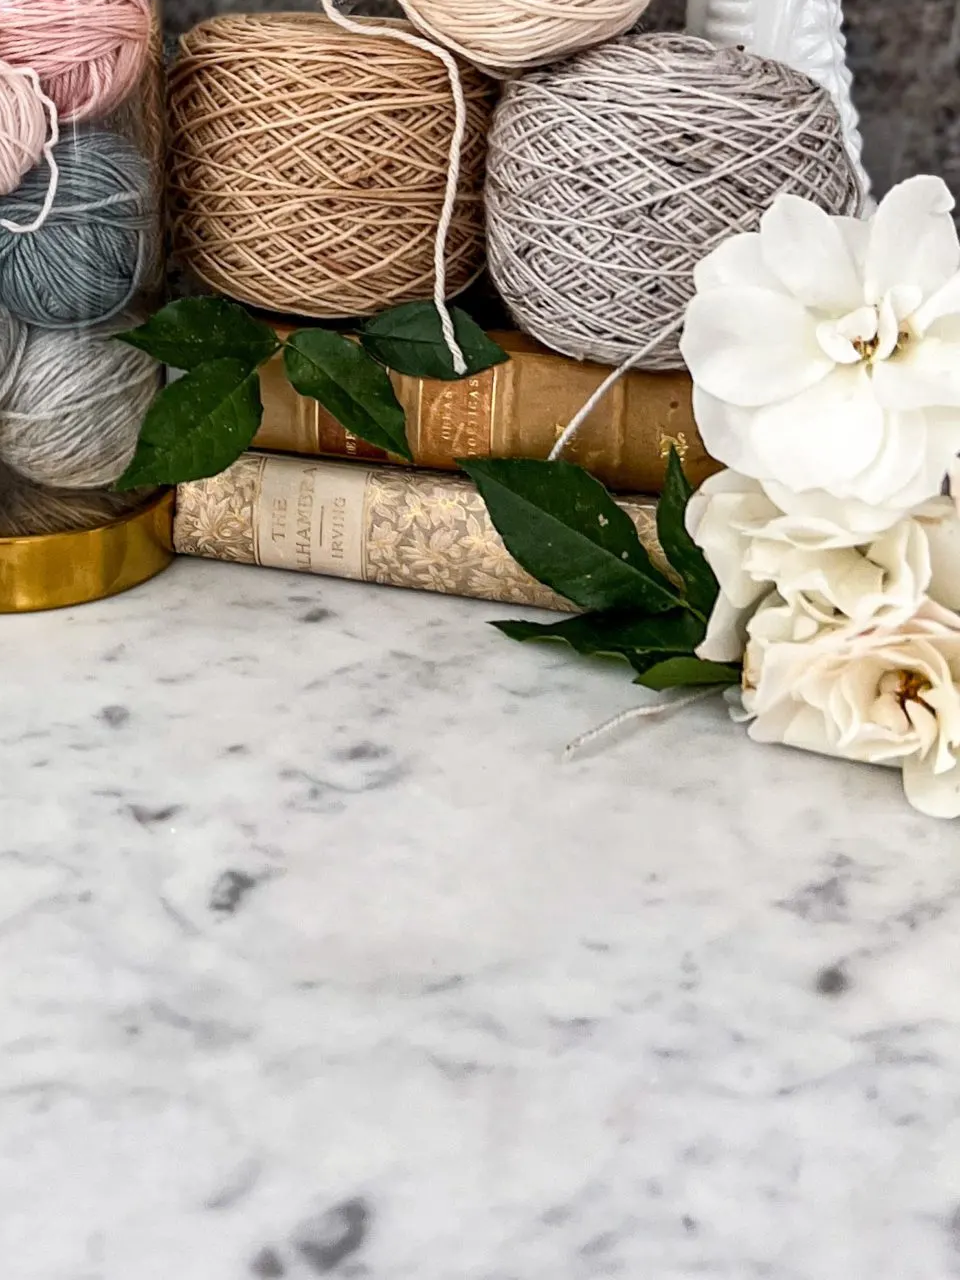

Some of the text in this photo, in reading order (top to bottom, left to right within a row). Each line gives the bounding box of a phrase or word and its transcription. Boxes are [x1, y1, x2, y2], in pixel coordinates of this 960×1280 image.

[271, 497, 287, 543] THE
[295, 467, 317, 573] ALHAMBRA
[331, 496, 346, 560] IRVING
